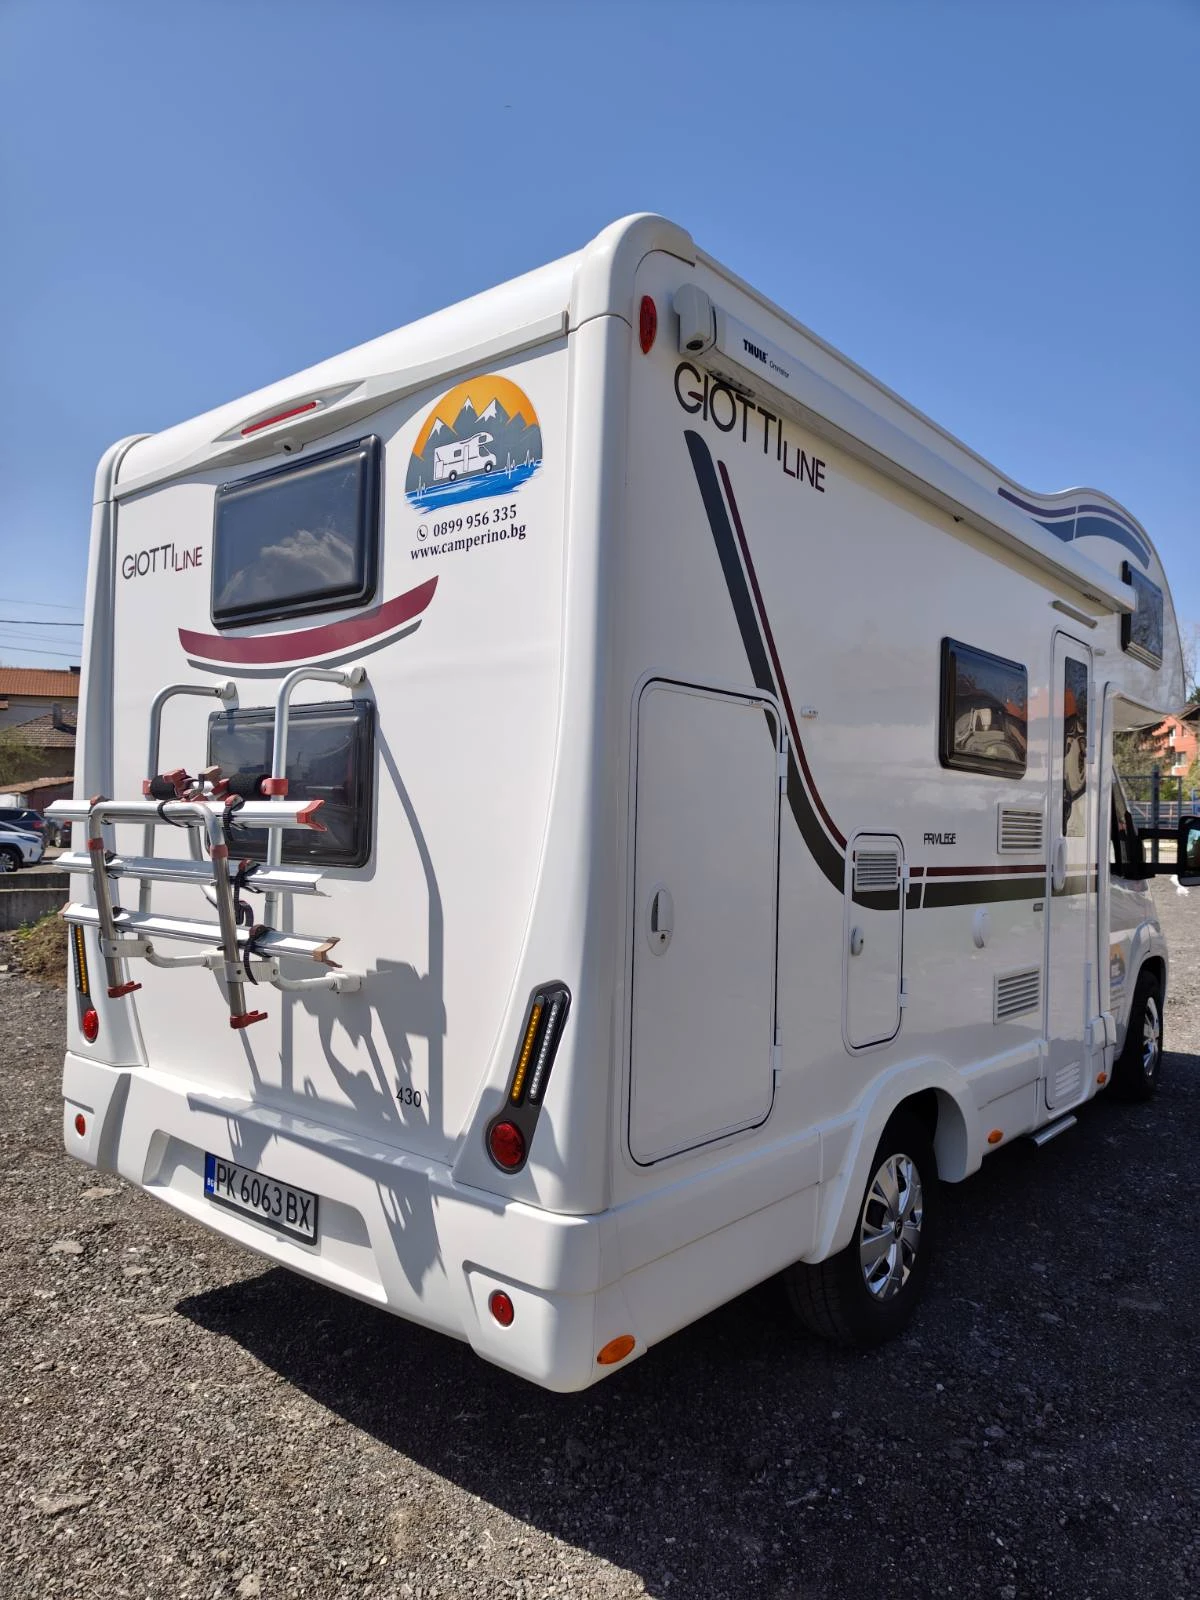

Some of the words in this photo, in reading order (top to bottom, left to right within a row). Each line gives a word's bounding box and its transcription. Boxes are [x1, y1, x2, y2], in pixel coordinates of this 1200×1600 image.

[743, 338, 767, 364] THULE
[433, 517, 463, 537] 0899
[466, 511, 489, 530] 956
[492, 504, 517, 523] 335
[410, 523, 527, 560] www.camperino.bg
[395, 1087, 422, 1108] 430
[216, 1162, 238, 1200] PK
[240, 1174, 283, 1217] 6063
[286, 1191, 312, 1232] BX
